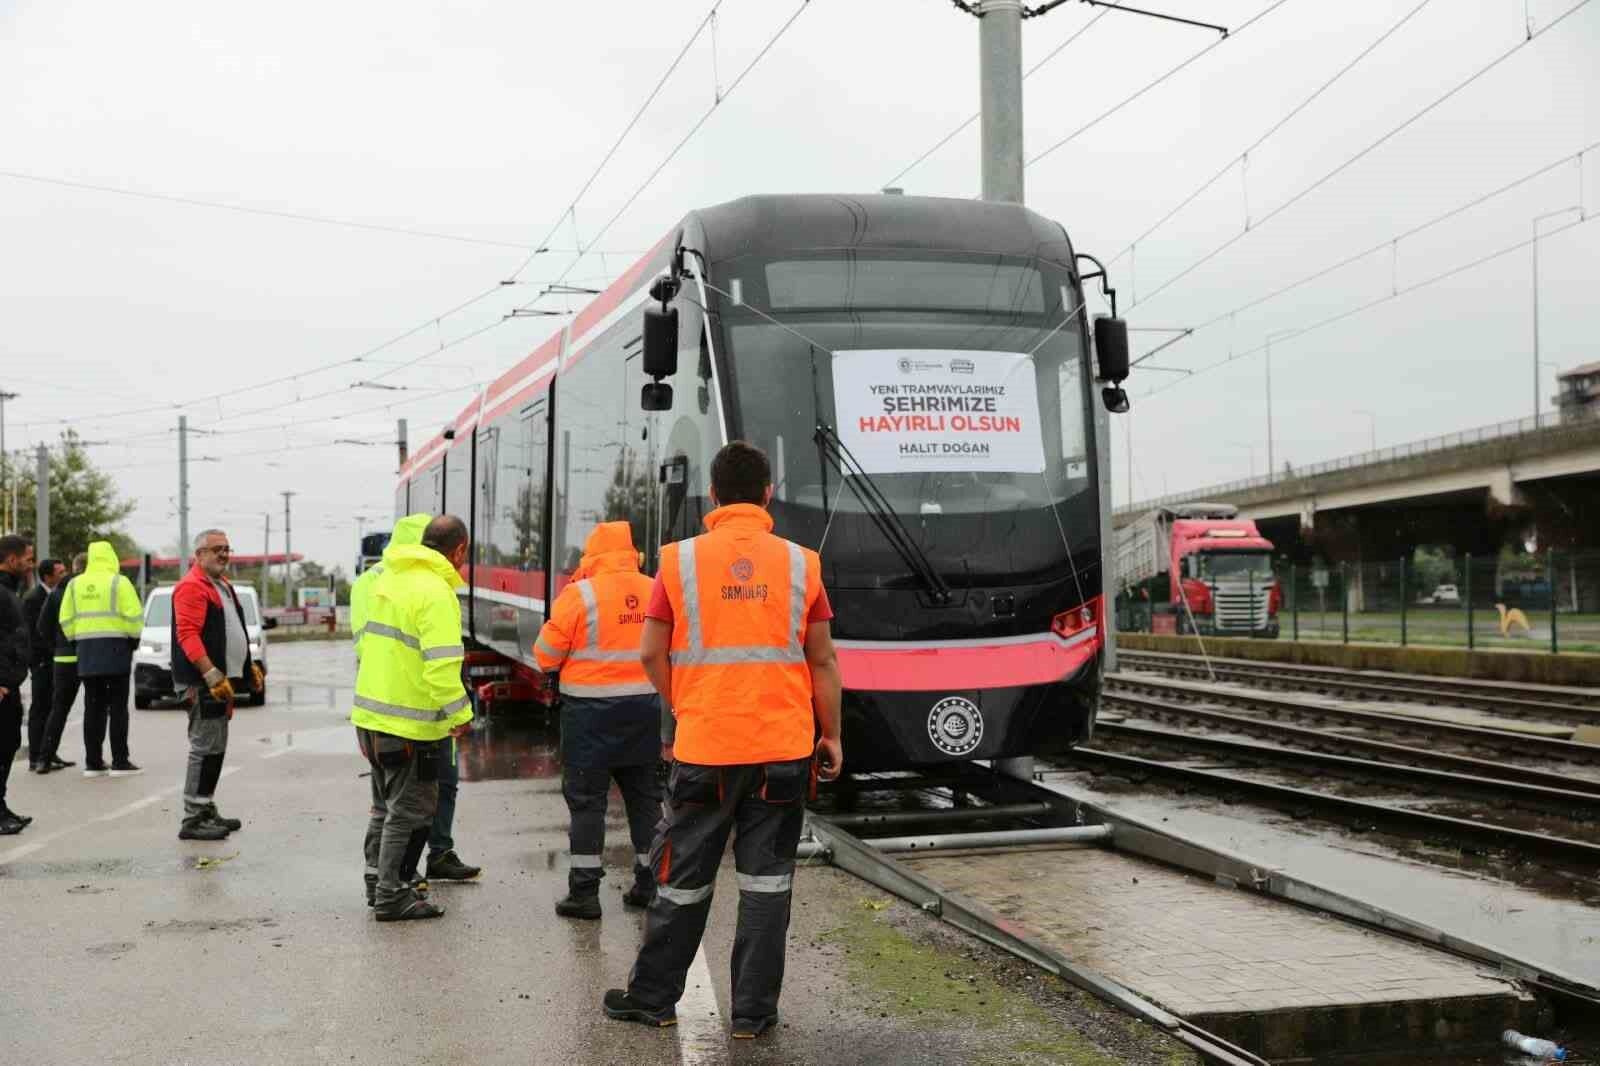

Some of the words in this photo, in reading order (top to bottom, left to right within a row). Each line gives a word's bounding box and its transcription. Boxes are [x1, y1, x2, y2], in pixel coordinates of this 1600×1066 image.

[883, 396, 997, 415] ŞEHRİMİZE
[859, 415, 945, 432] HAYIRLI
[950, 415, 1021, 432] OLSUN
[942, 442, 990, 453] DOĞAN
